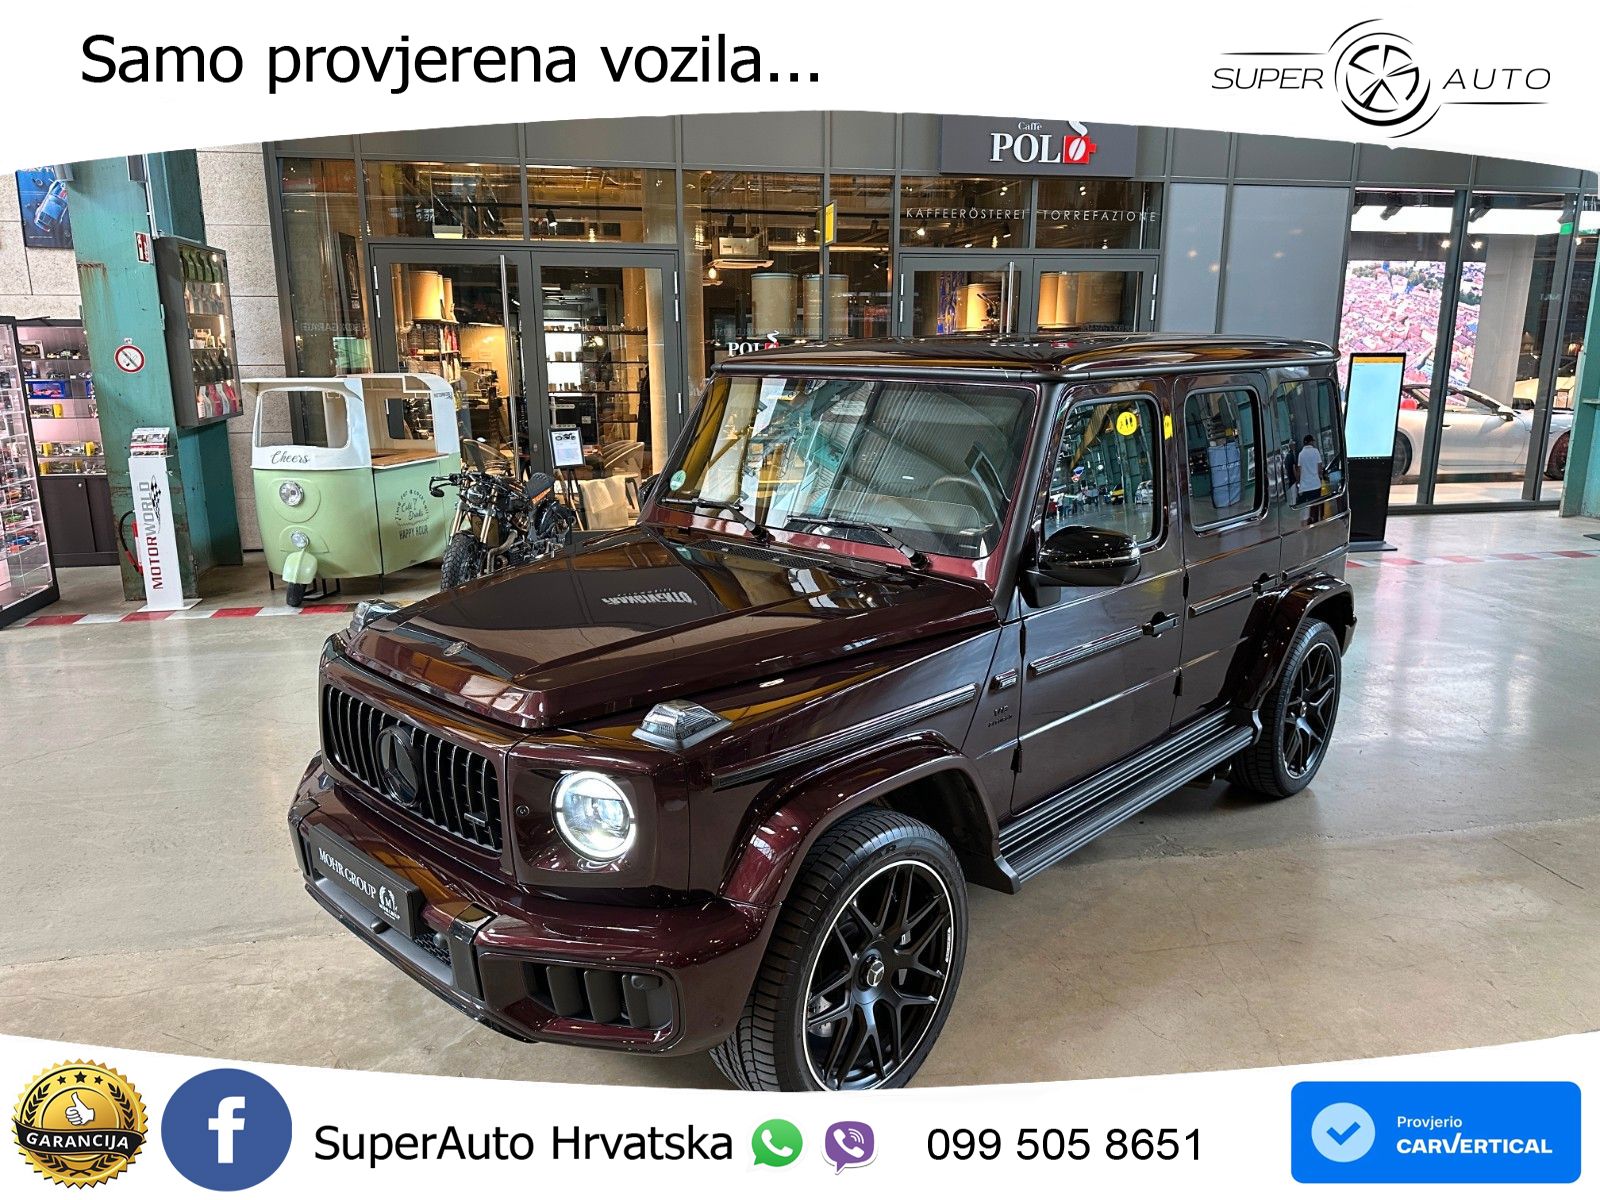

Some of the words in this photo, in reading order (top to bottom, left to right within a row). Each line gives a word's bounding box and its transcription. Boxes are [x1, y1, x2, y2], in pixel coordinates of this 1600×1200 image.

[906, 206, 1025, 220] KAFFEERÖSTEREI
[1042, 209, 1156, 222] TORREFAZIONE
[271, 450, 310, 464] Cheers
[139, 481, 164, 590] MOTORWORLD
[318, 847, 345, 878] MOHR
[344, 867, 377, 899] GROUP
